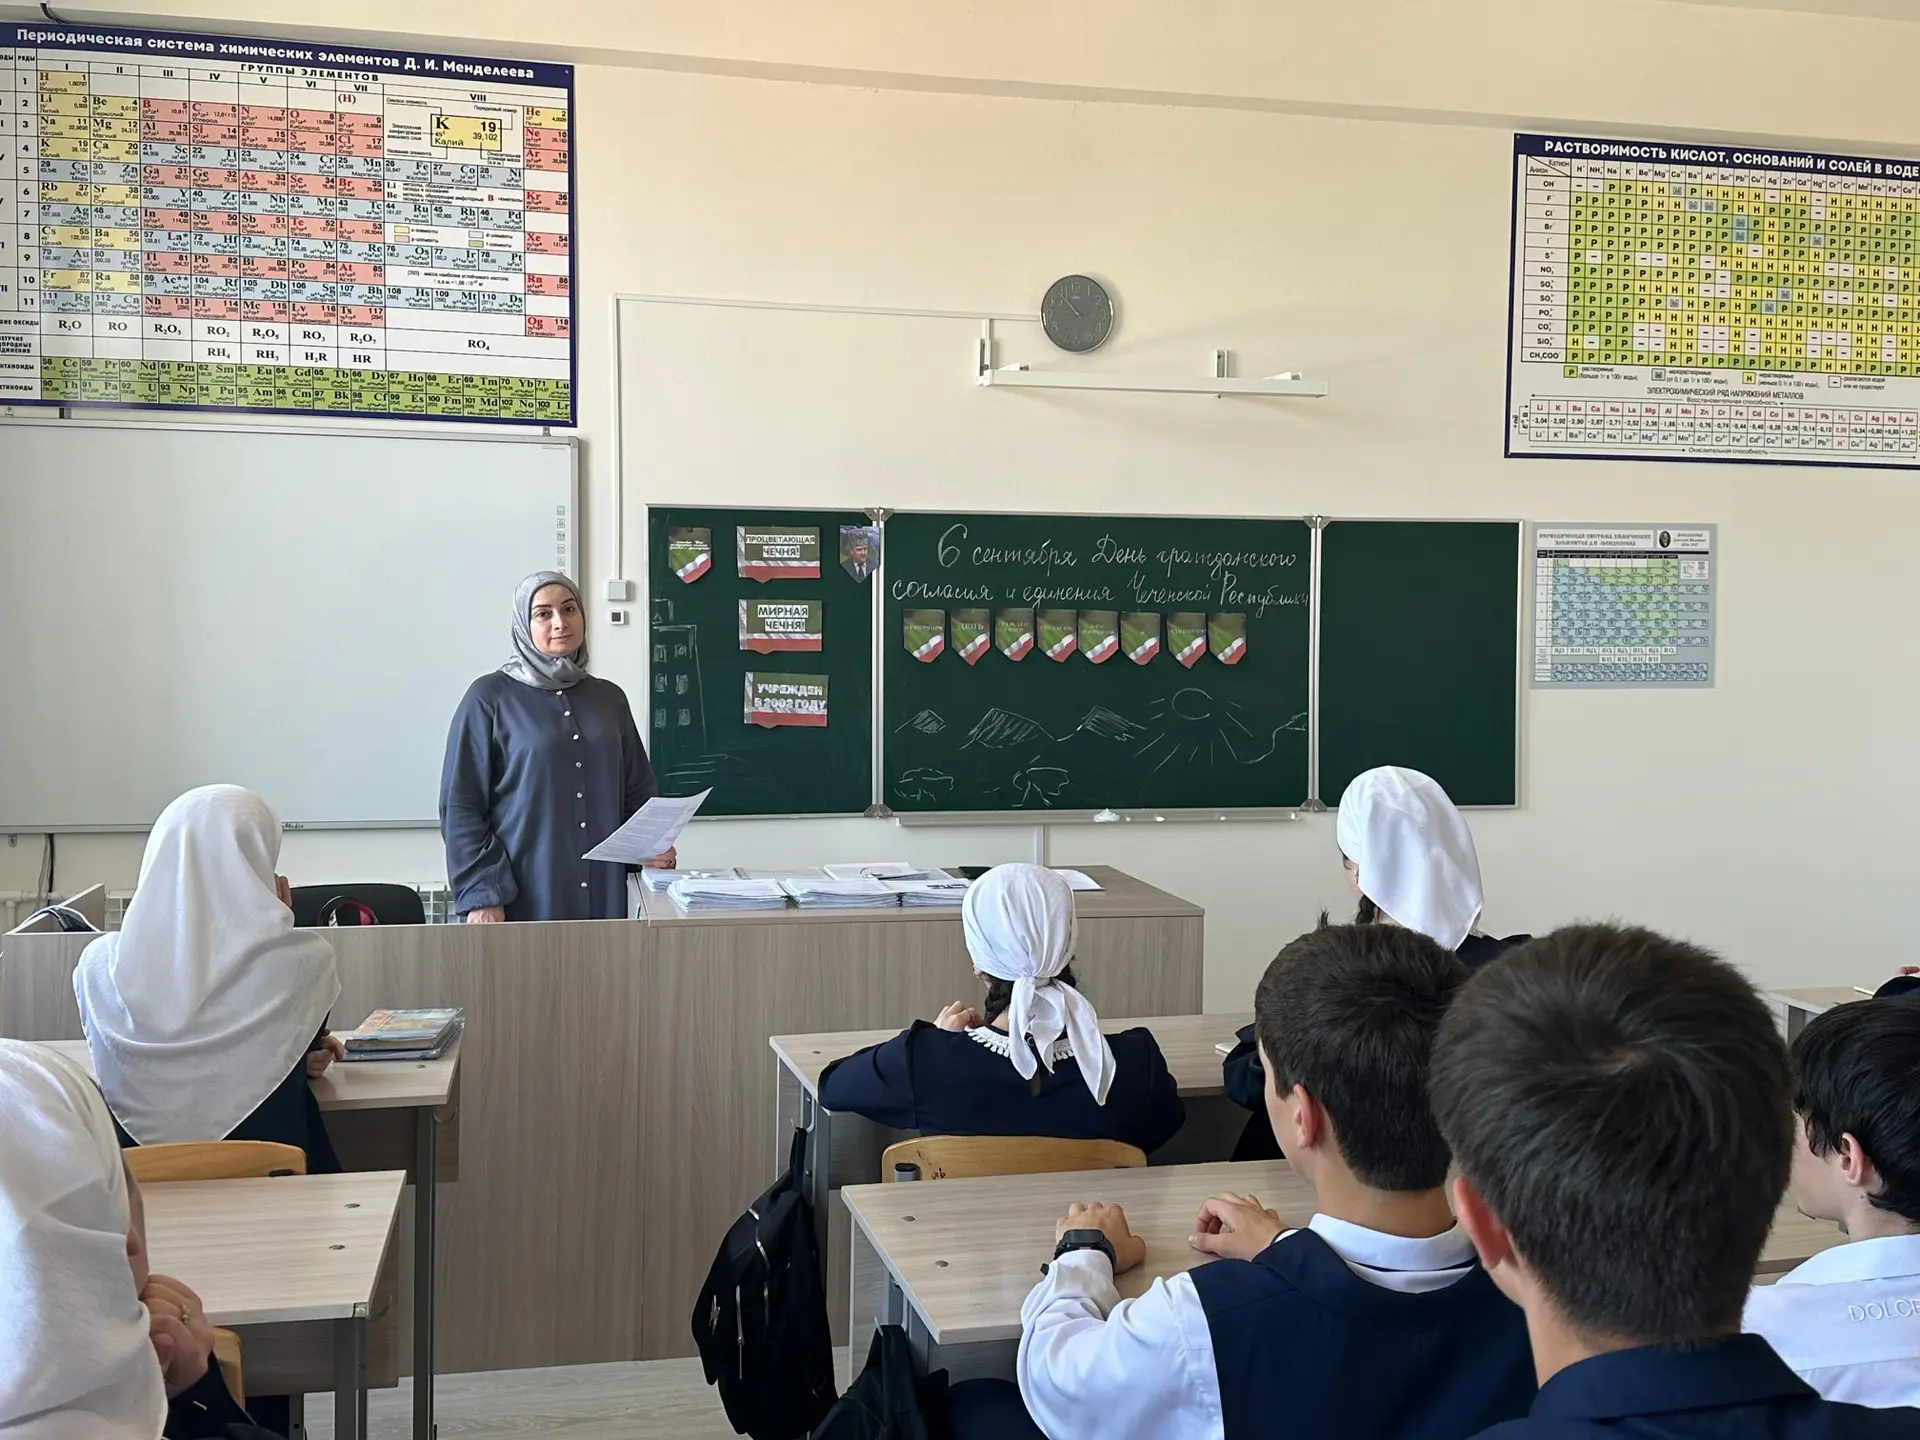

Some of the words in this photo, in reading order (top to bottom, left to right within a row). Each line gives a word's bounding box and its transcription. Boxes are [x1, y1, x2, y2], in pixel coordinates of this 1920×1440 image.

[17, 28, 142, 47] Периодическая
[148, 38, 214, 52] система
[220, 44, 313, 60] химических
[318, 52, 400, 67] элементов
[404, 58, 420, 71] Д.
[424, 59, 439, 71] И.
[443, 60, 534, 78] Менделеева
[40, 72, 49, 80] H
[241, 64, 295, 75] ГРУППЫ
[301, 68, 378, 81] ЭЛЕМЕНТОВ
[40, 94, 52, 102] Li
[93, 97, 107, 105] Be
[338, 94, 356, 104] (H)
[526, 108, 540, 116] He
[40, 116, 56, 125] Na
[93, 119, 112, 129] Mg
[435, 117, 450, 130] K
[480, 122, 496, 132] 19
[143, 122, 155, 130] Al
[290, 132, 297, 140] S
[338, 135, 350, 144] Cl
[473, 132, 497, 141] 39,102
[41, 139, 51, 147] K
[93, 141, 109, 149] Ca
[435, 138, 464, 146] Калий
[526, 149, 540, 158] Ar
[363, 158, 381, 167] Mn
[1544, 140, 1667, 159] РАСТВОРИМОСТЬ
[1670, 149, 1729, 164] КИСЛОТ,
[1732, 152, 1814, 169] ОСНОВАНИЙ
[1817, 158, 1825, 169] И
[1829, 159, 1872, 174] СОЛЕЙ
[1875, 163, 1882, 174] В
[1886, 164, 1919, 178] ВОДЕ
[72, 162, 88, 171] Cu
[242, 172, 256, 180] As
[73, 206, 89, 216] Ag
[73, 250, 89, 258] Au
[511, 253, 522, 261] Pt
[194, 255, 208, 263] Pb
[24, 298, 34, 306] 11
[108, 322, 127, 331] RO
[353, 354, 372, 363] HR
[1647, 387, 1716, 396] ЭЛЕКТРОХИМИЧЕСКИЙ
[1730, 390, 1771, 398] НАПРЯЖЕНИЙ
[557, 402, 570, 410] Lr
[746, 535, 815, 544] ПРОЦВЕТАЮЩАЯ
[764, 548, 799, 556] ЧЕЧНЯ!
[938, 523, 968, 568] 6
[972, 538, 1077, 577] сентября
[1092, 534, 1147, 564] День
[1157, 548, 1296, 580] гражданского
[892, 580, 993, 600] согласия
[1006, 588, 1016, 599] и
[1023, 586, 1115, 608] единения
[1127, 570, 1211, 604] Чеченской
[1220, 570, 1309, 618] Республики
[758, 606, 808, 616] МИРНАЯ
[765, 621, 805, 630] ЧЕЧНЯ!
[757, 684, 822, 697] УЧРЕЖДЕН
[754, 698, 762, 707] В
[764, 698, 794, 708] 2002
[795, 699, 826, 710] ГОДУ
